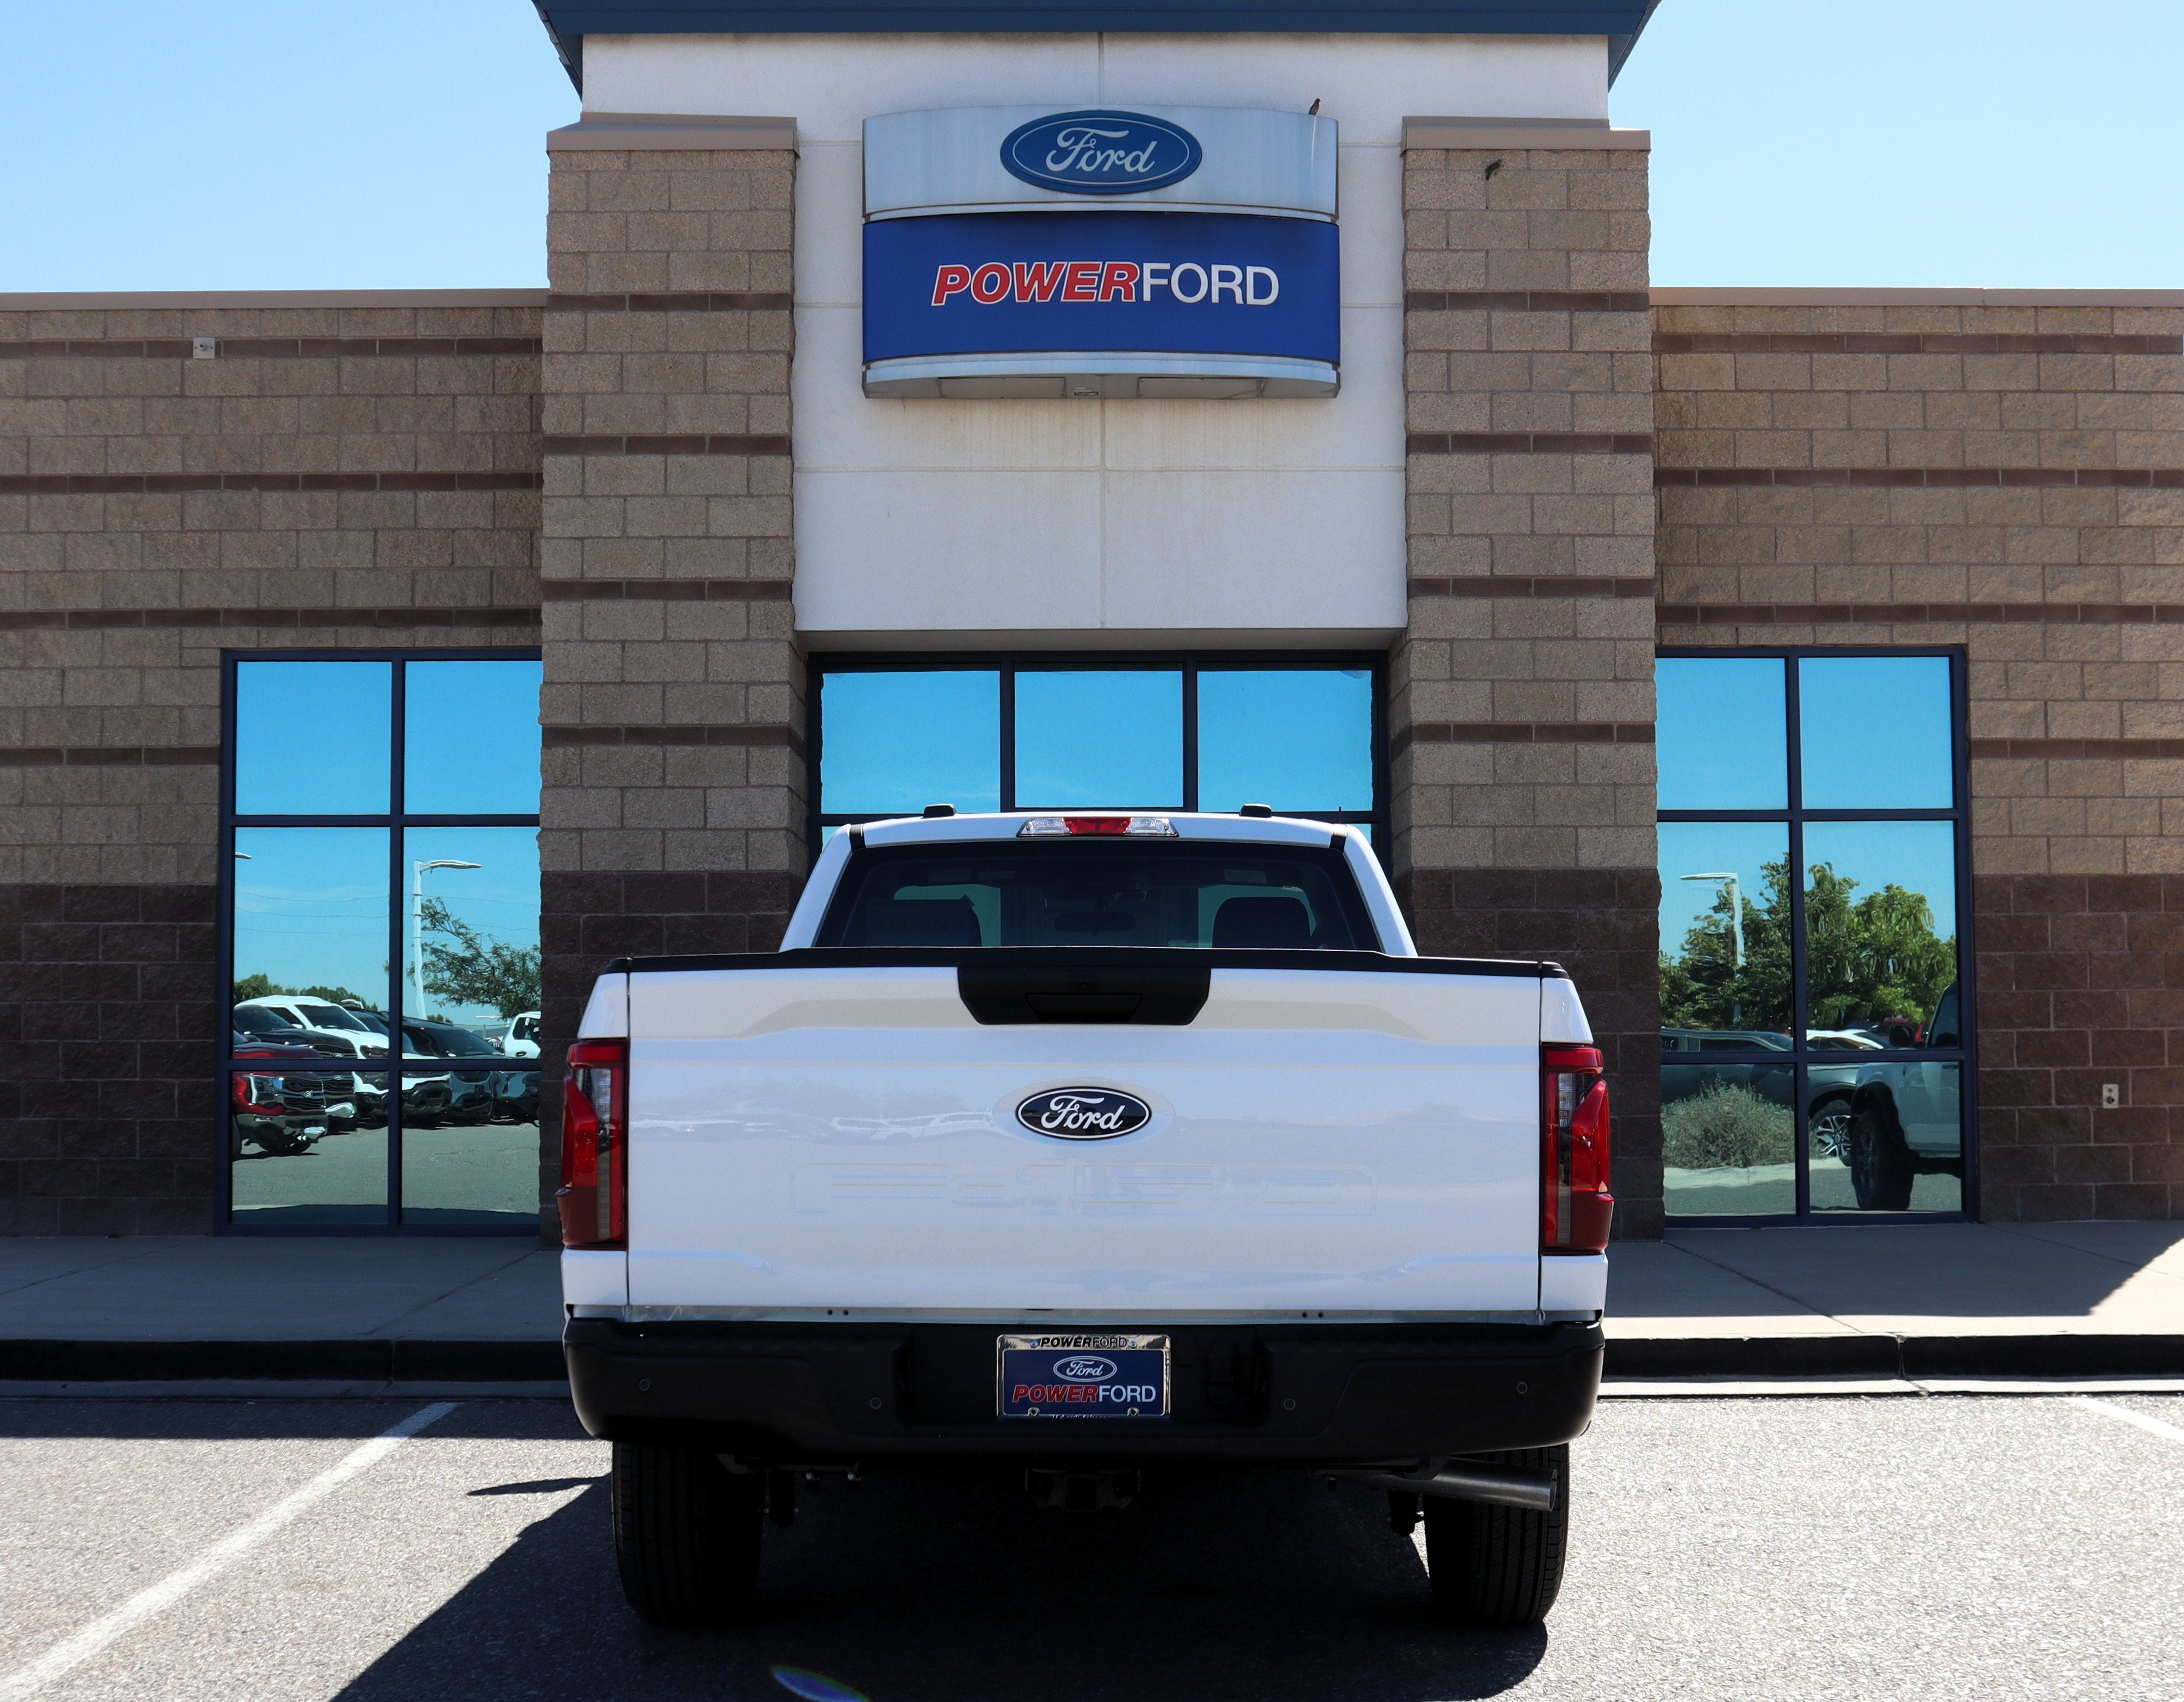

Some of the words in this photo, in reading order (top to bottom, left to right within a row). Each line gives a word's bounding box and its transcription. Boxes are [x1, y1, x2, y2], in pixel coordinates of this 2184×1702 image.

[1046, 127, 1158, 173] Ford
[931, 261, 1279, 306] POWERFORD
[1041, 1095, 1126, 1130] Ford
[1040, 1337, 1127, 1348] POWERFORD
[1066, 1360, 1104, 1376] Ford
[1012, 1384, 1156, 1403] POWERFORD
